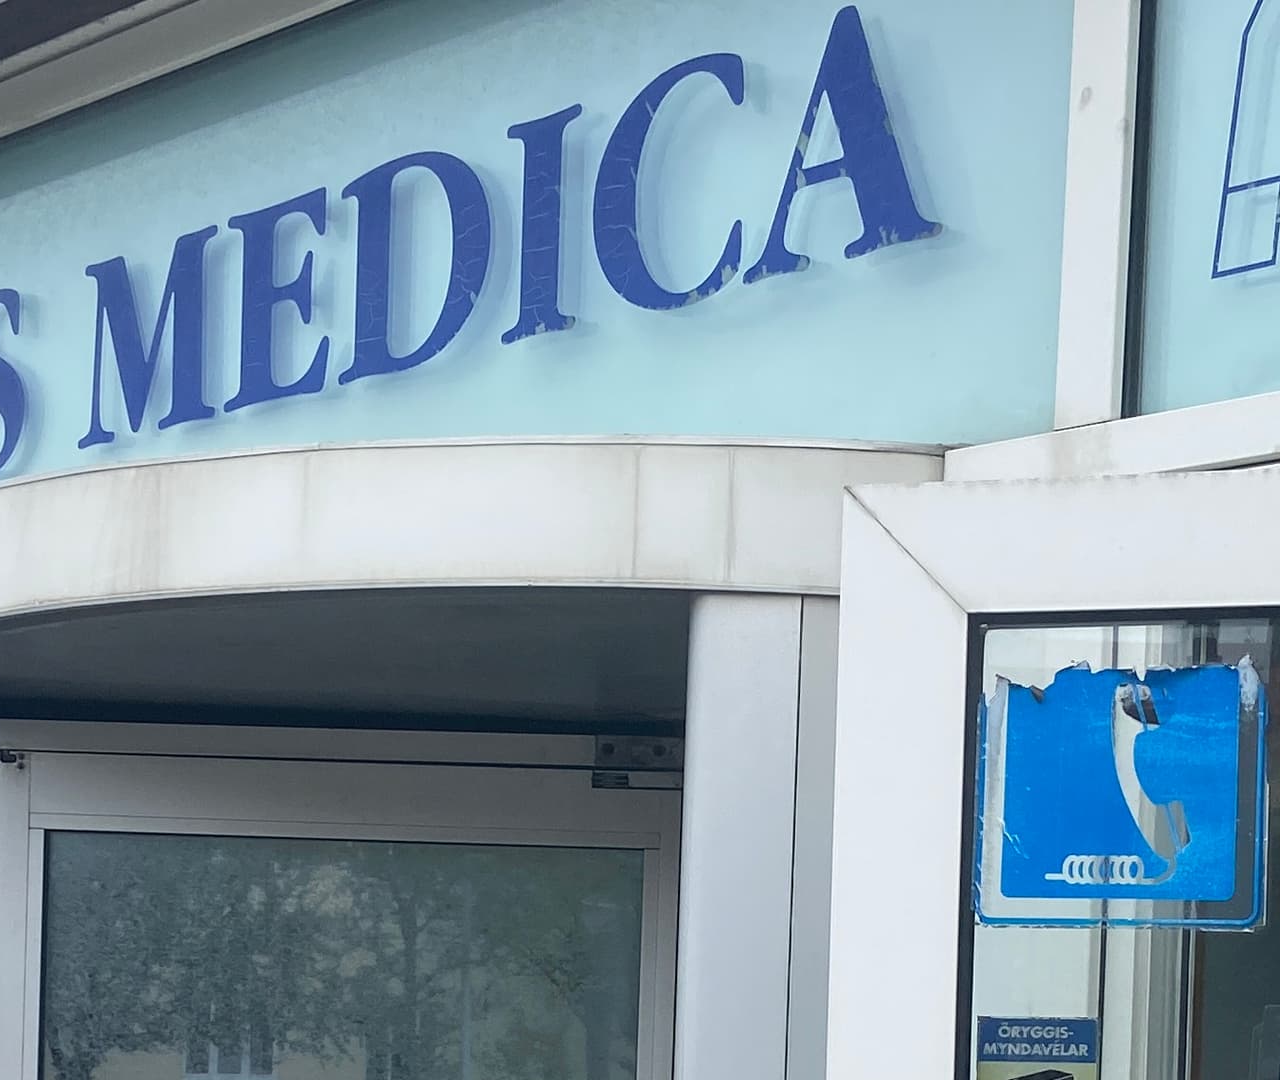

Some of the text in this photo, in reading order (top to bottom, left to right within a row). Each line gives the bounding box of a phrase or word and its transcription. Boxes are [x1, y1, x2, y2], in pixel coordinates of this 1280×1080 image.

[77, 5, 944, 449] MEDICA
[998, 1022, 1074, 1039] ÖRYGGIS-
[983, 1040, 1089, 1057] MYNDAVÉLAR
